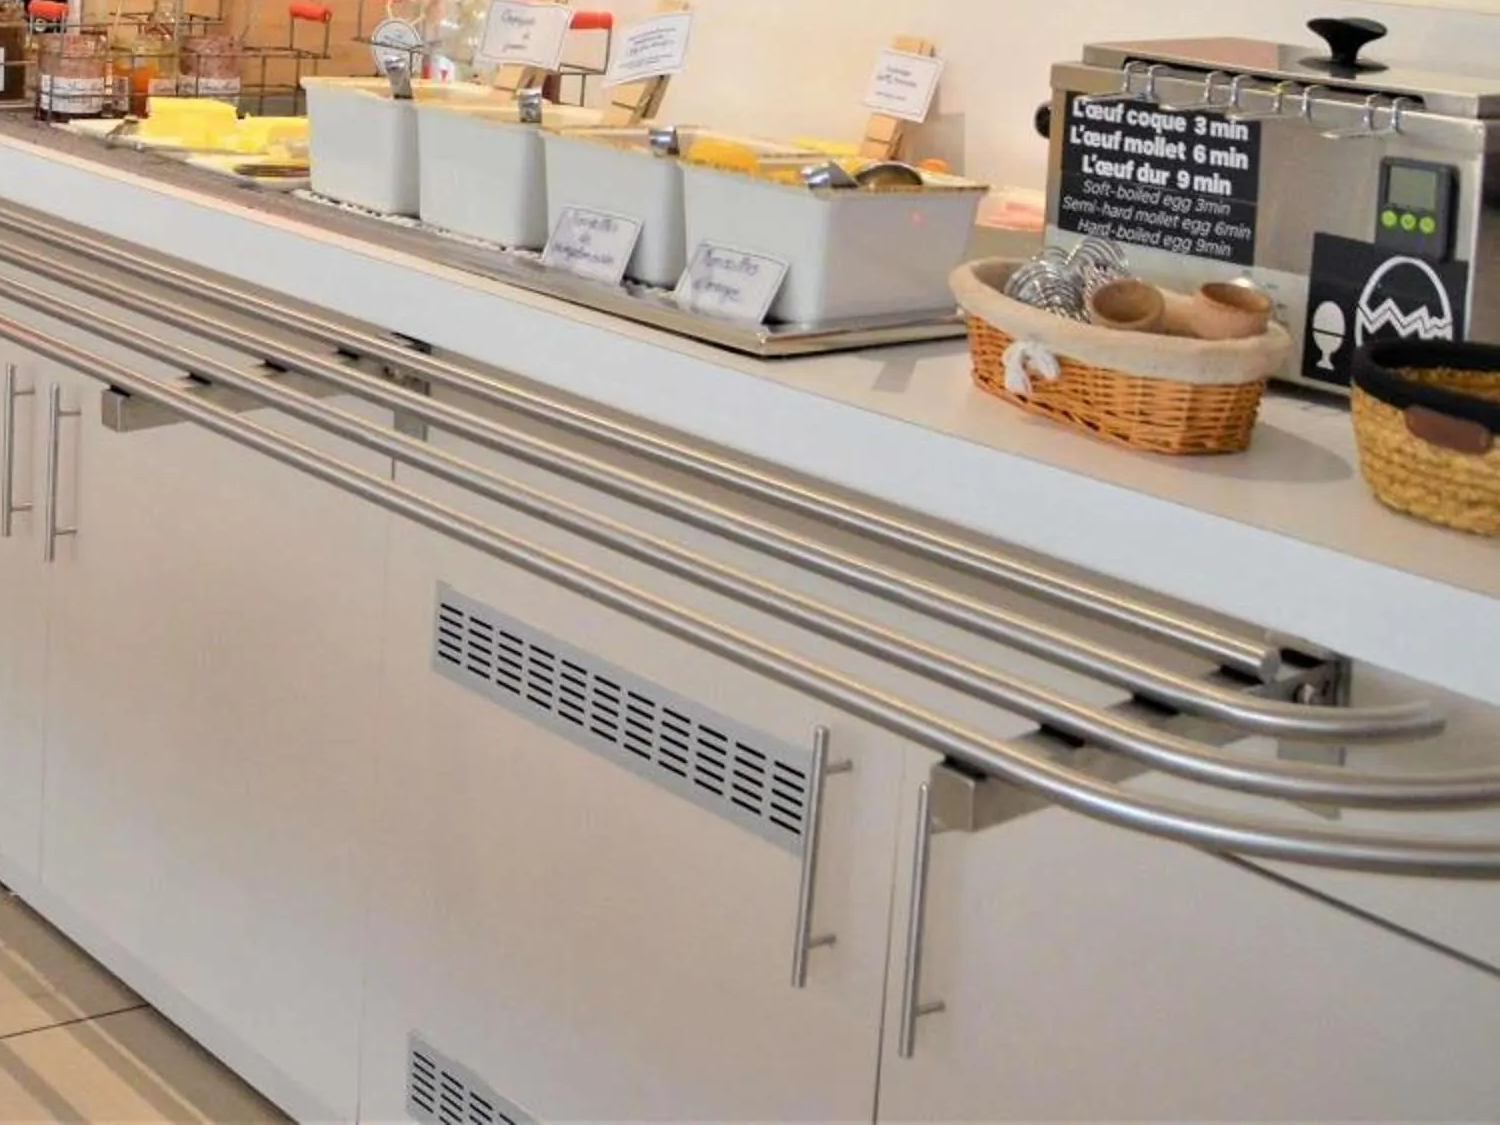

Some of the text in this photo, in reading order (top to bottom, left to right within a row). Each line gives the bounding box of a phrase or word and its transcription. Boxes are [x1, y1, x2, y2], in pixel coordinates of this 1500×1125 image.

[1126, 110, 1187, 134] coque
[1193, 116, 1207, 136] 3
[1209, 118, 1249, 141] min
[1124, 135, 1187, 161] mollet
[1193, 144, 1207, 164] 6
[1209, 147, 1249, 171] min
[1083, 179, 1231, 216] Soft-boiled egg 3min
[1136, 163, 1170, 186] dur
[1176, 170, 1190, 190] 9
[1193, 173, 1232, 196] min
[1062, 196, 1252, 241] Semi-hard mollet egg 6min
[1077, 218, 1232, 257] Hard-boiled egg 9min
